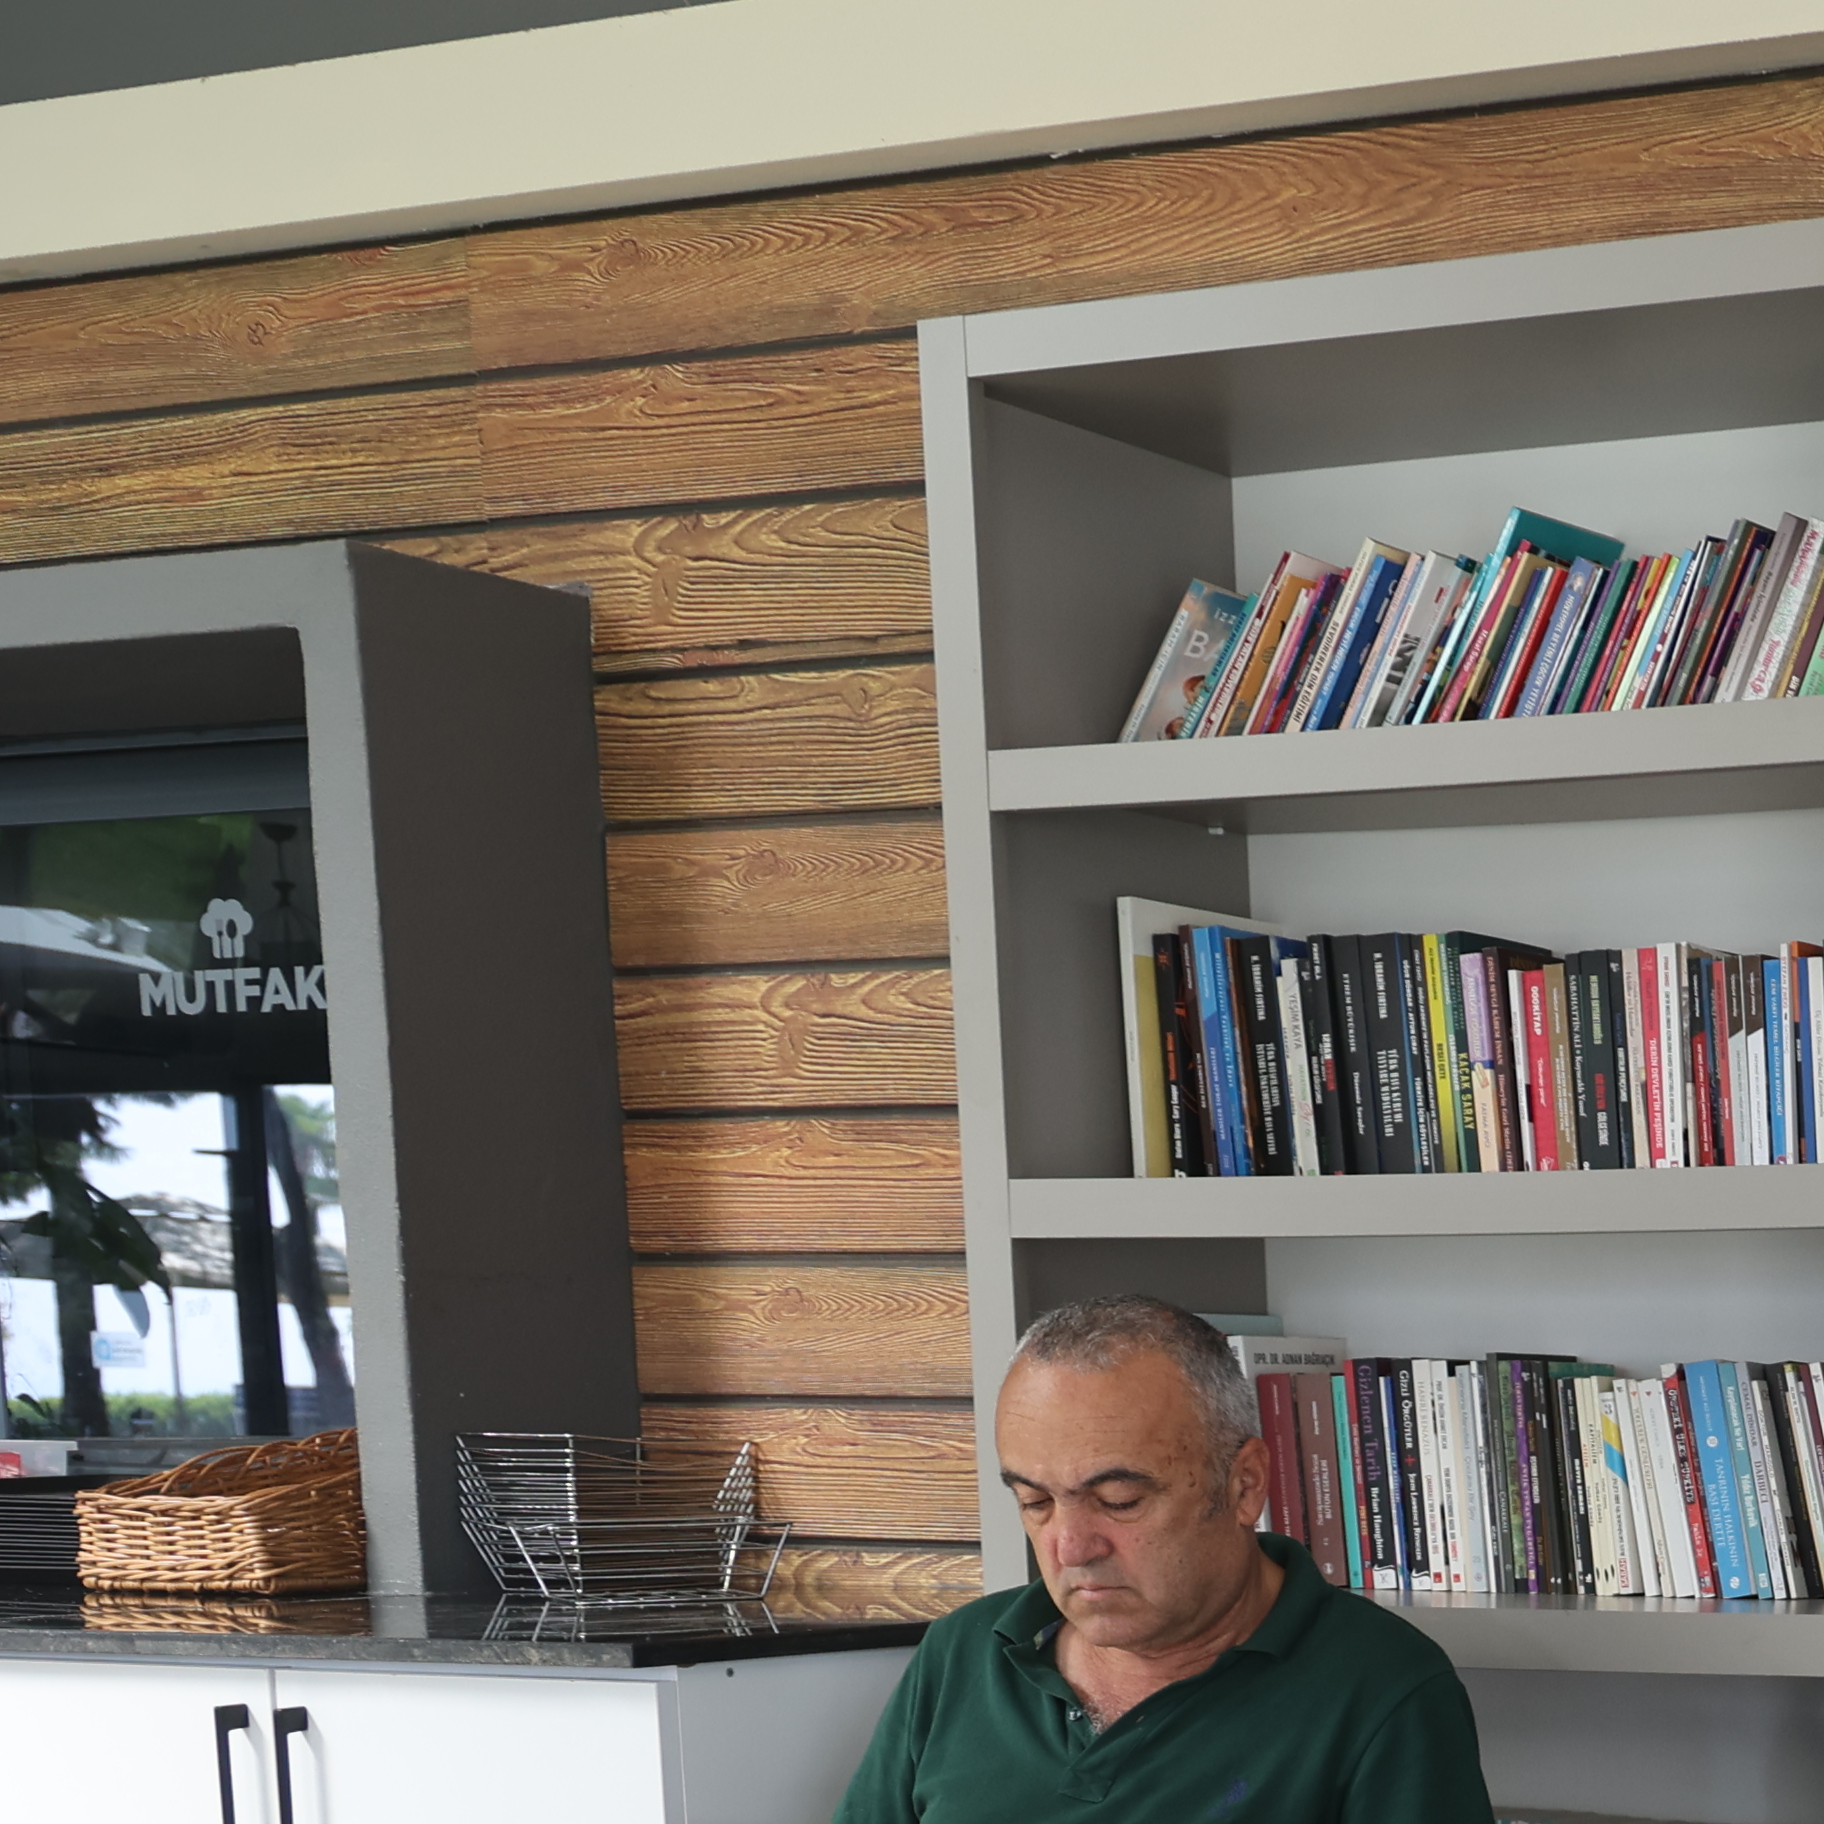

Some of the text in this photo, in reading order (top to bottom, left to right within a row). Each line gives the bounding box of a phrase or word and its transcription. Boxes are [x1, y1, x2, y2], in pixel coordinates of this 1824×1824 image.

[1553, 593, 1577, 634] MÜKEMMEL
[1291, 619, 1340, 724] SEVDİREREK DİN EĞİTİMİ
[1532, 660, 1552, 689] ÇOCUK
[139, 964, 328, 1018] MUTFAK
[1288, 992, 1302, 1050] YEŞİM KAYA
[1569, 974, 1587, 1117] SABAHATTİN ALİ Kuyucaklı Yusuf
[1497, 1074, 1508, 1106] Hüseyin
[1461, 1094, 1475, 1130] SARAY
[1653, 1113, 1664, 1149] PEŞİNDE
[1270, 1352, 1282, 1366] DR.
[1283, 1352, 1304, 1366] ADNAN
[1740, 1381, 1752, 1411] CEMAL
[1746, 1412, 1758, 1447] DİNDAR
[1357, 1363, 1385, 1559] Gizlenen Tarih Brian Haughton
[1588, 1423, 1598, 1465] KAPİTALİZM
[1740, 1473, 1753, 1496] Yıldız
[1322, 1494, 1333, 1520] BÜTÜN
[1714, 1458, 1739, 1567] TANRININ HALKININ
[1712, 1509, 1725, 1547] DERTTE
